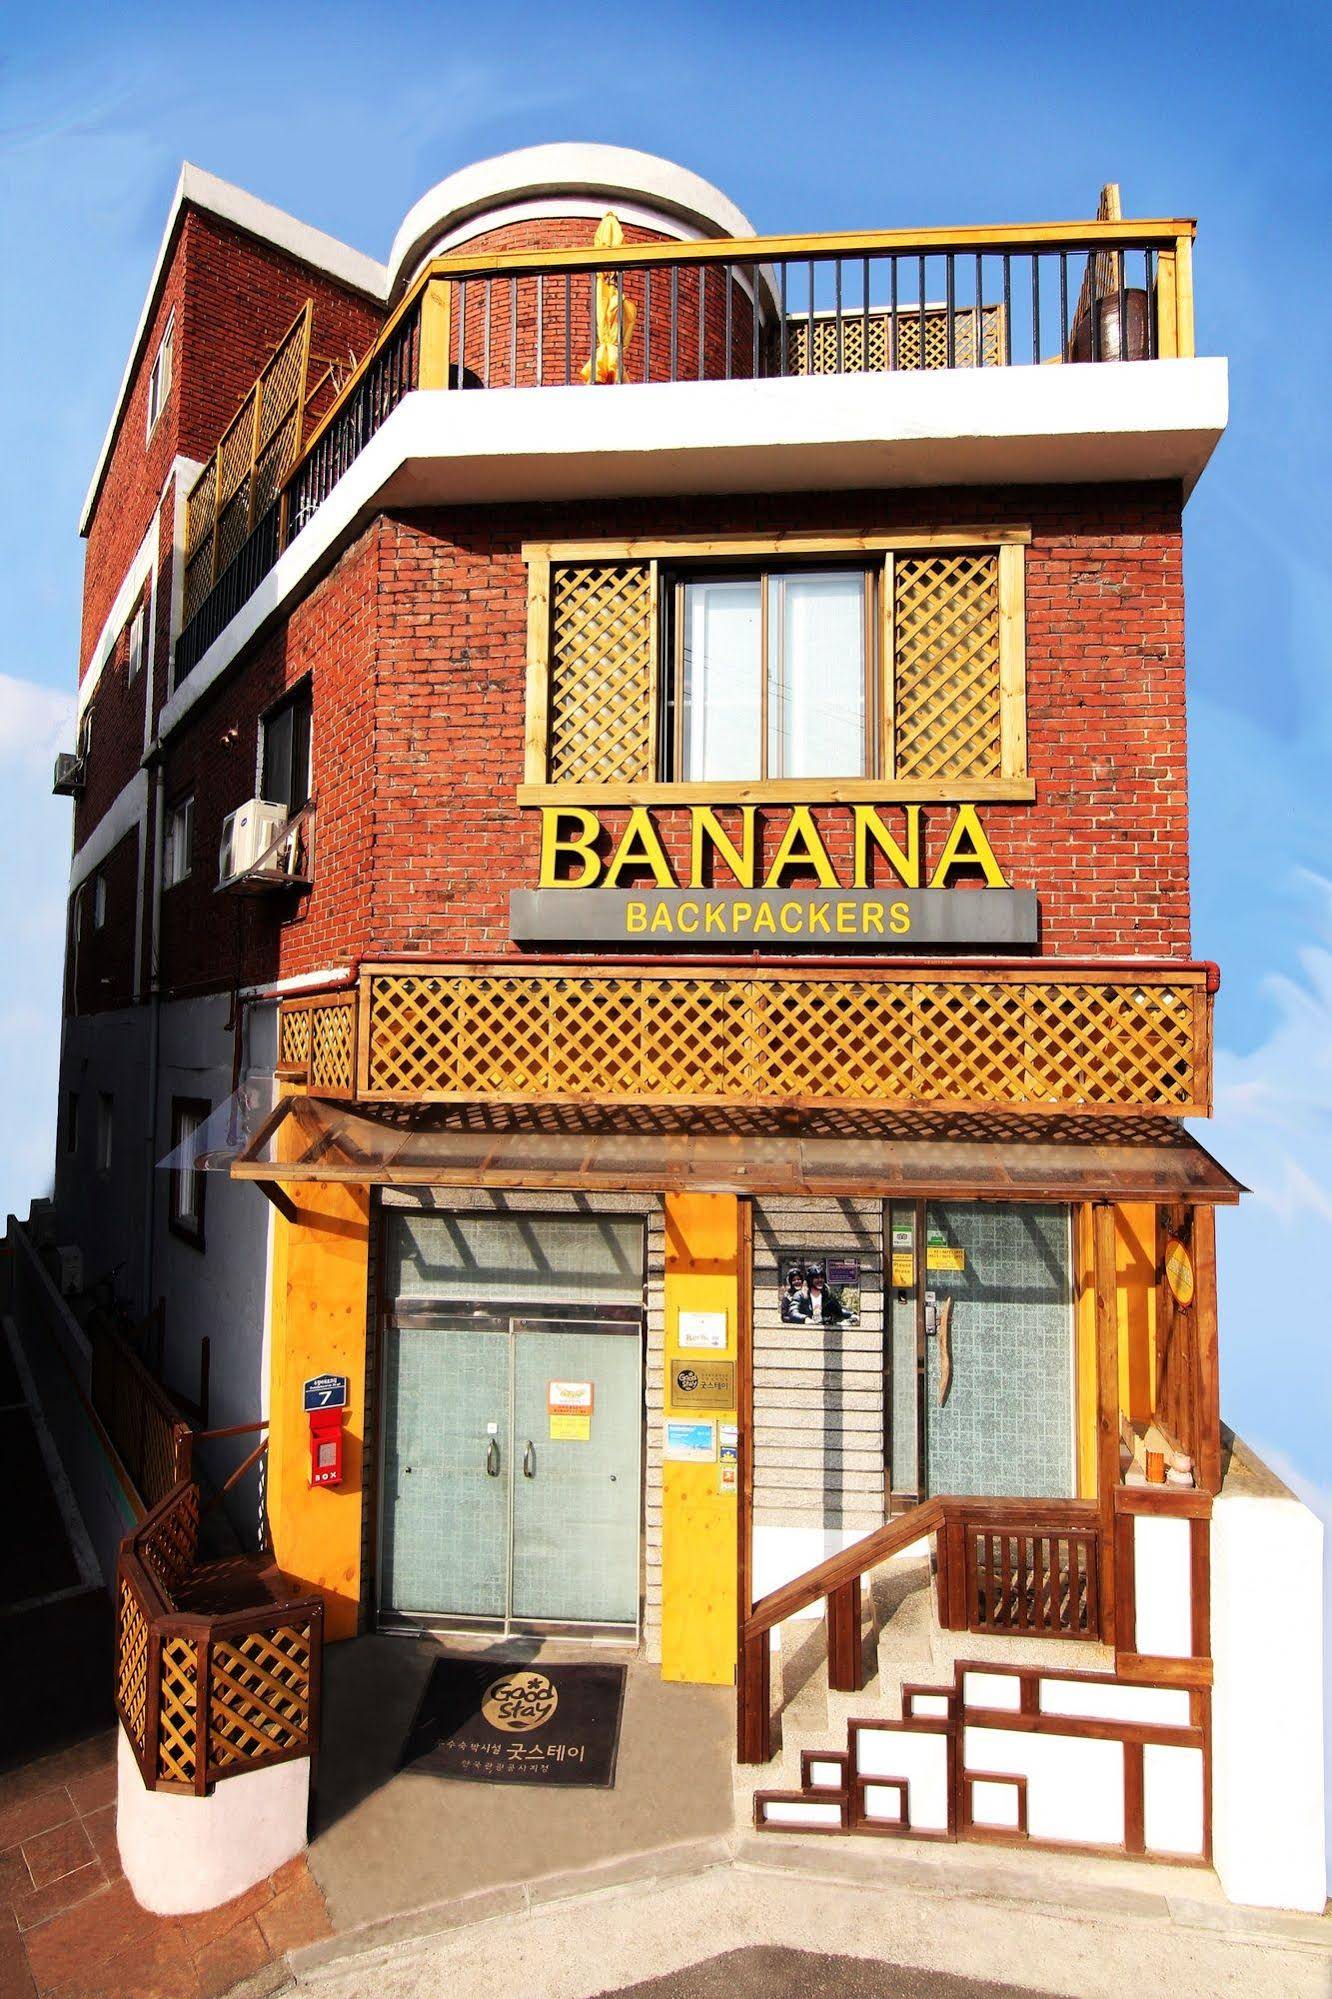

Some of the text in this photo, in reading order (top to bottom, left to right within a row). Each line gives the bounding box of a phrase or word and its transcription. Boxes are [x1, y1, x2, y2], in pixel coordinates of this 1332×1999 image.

[537, 805, 1013, 889] BANANA
[625, 901, 912, 934] BACKPACKERS
[318, 1390, 333, 1406] 7
[315, 1471, 337, 1482] BOX
[490, 1682, 554, 1702] Good
[506, 1743, 585, 1762] 굿스테이
